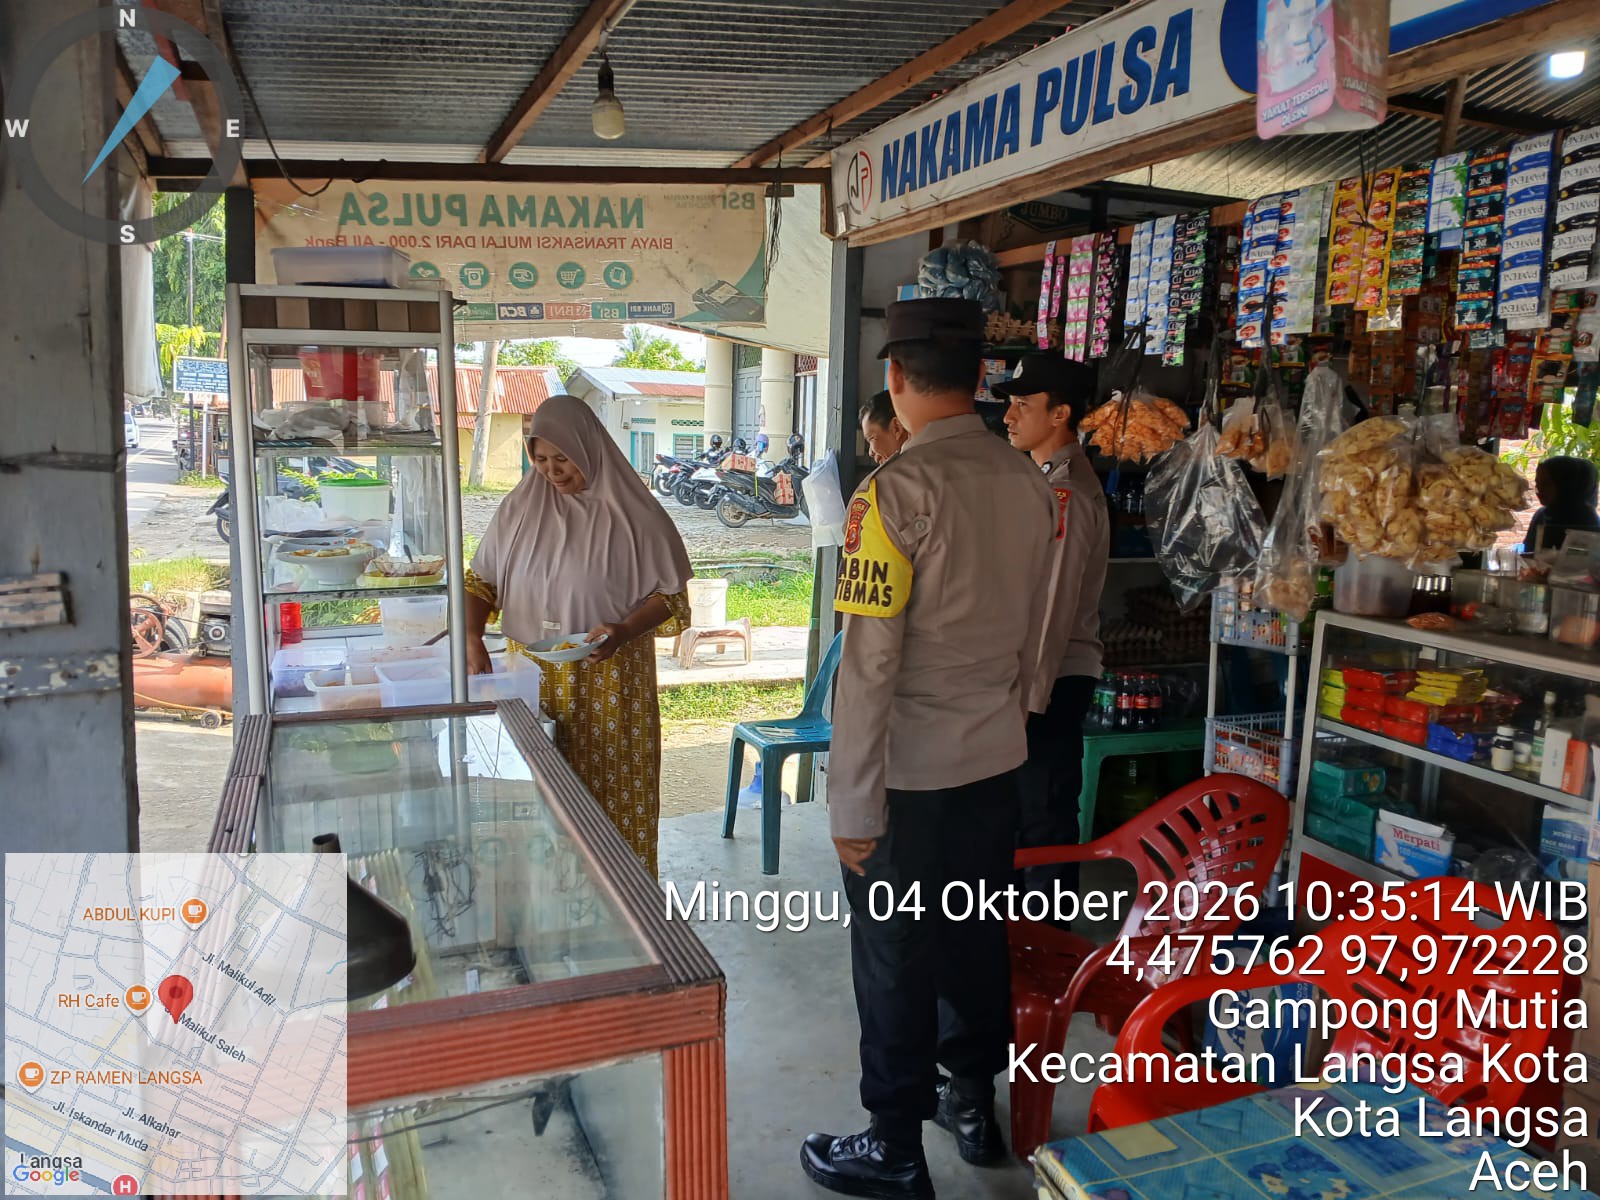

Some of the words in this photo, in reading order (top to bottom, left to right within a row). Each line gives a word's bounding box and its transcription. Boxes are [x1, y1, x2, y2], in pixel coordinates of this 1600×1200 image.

[880, 83, 1021, 203] NAKAMA
[1030, 8, 1193, 147] PULSA
[1392, 827, 1441, 851] Merpati
